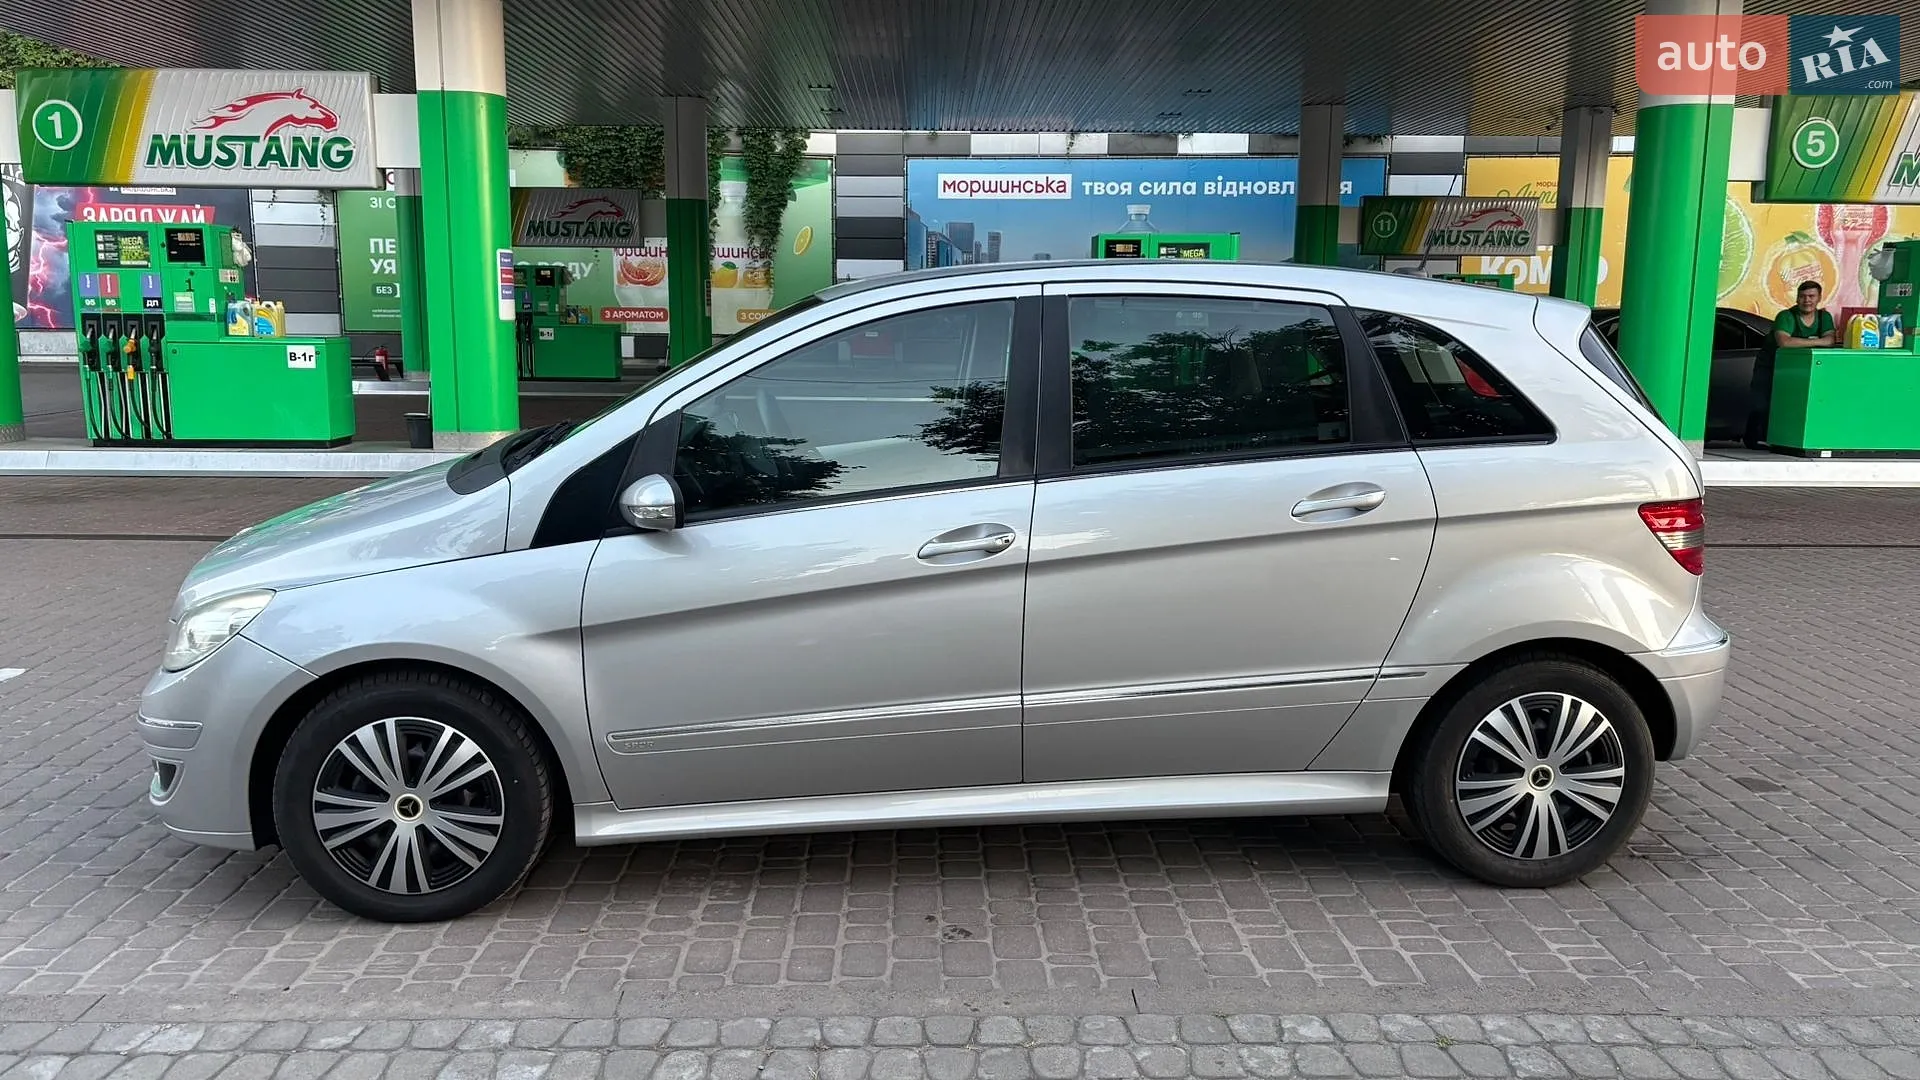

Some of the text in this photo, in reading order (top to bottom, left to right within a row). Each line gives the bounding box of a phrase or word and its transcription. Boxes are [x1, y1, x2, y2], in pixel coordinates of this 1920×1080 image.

[47, 111, 63, 139] 1
[145, 133, 355, 170] MUSTANG
[1806, 131, 1825, 157] 5
[943, 175, 1353, 198] моршинська твоя сила відновля
[526, 220, 633, 238] MUSTANG
[1377, 219, 1392, 231] 11
[369, 238, 397, 254] ПЕ
[1427, 229, 1530, 248] MUSTANG
[1182, 248, 1206, 258] MEGA
[369, 258, 397, 274] УЯ
[185, 279, 194, 292] 1
[375, 286, 393, 294] БЕЗ
[612, 310, 664, 319] АРОМАТОМ
